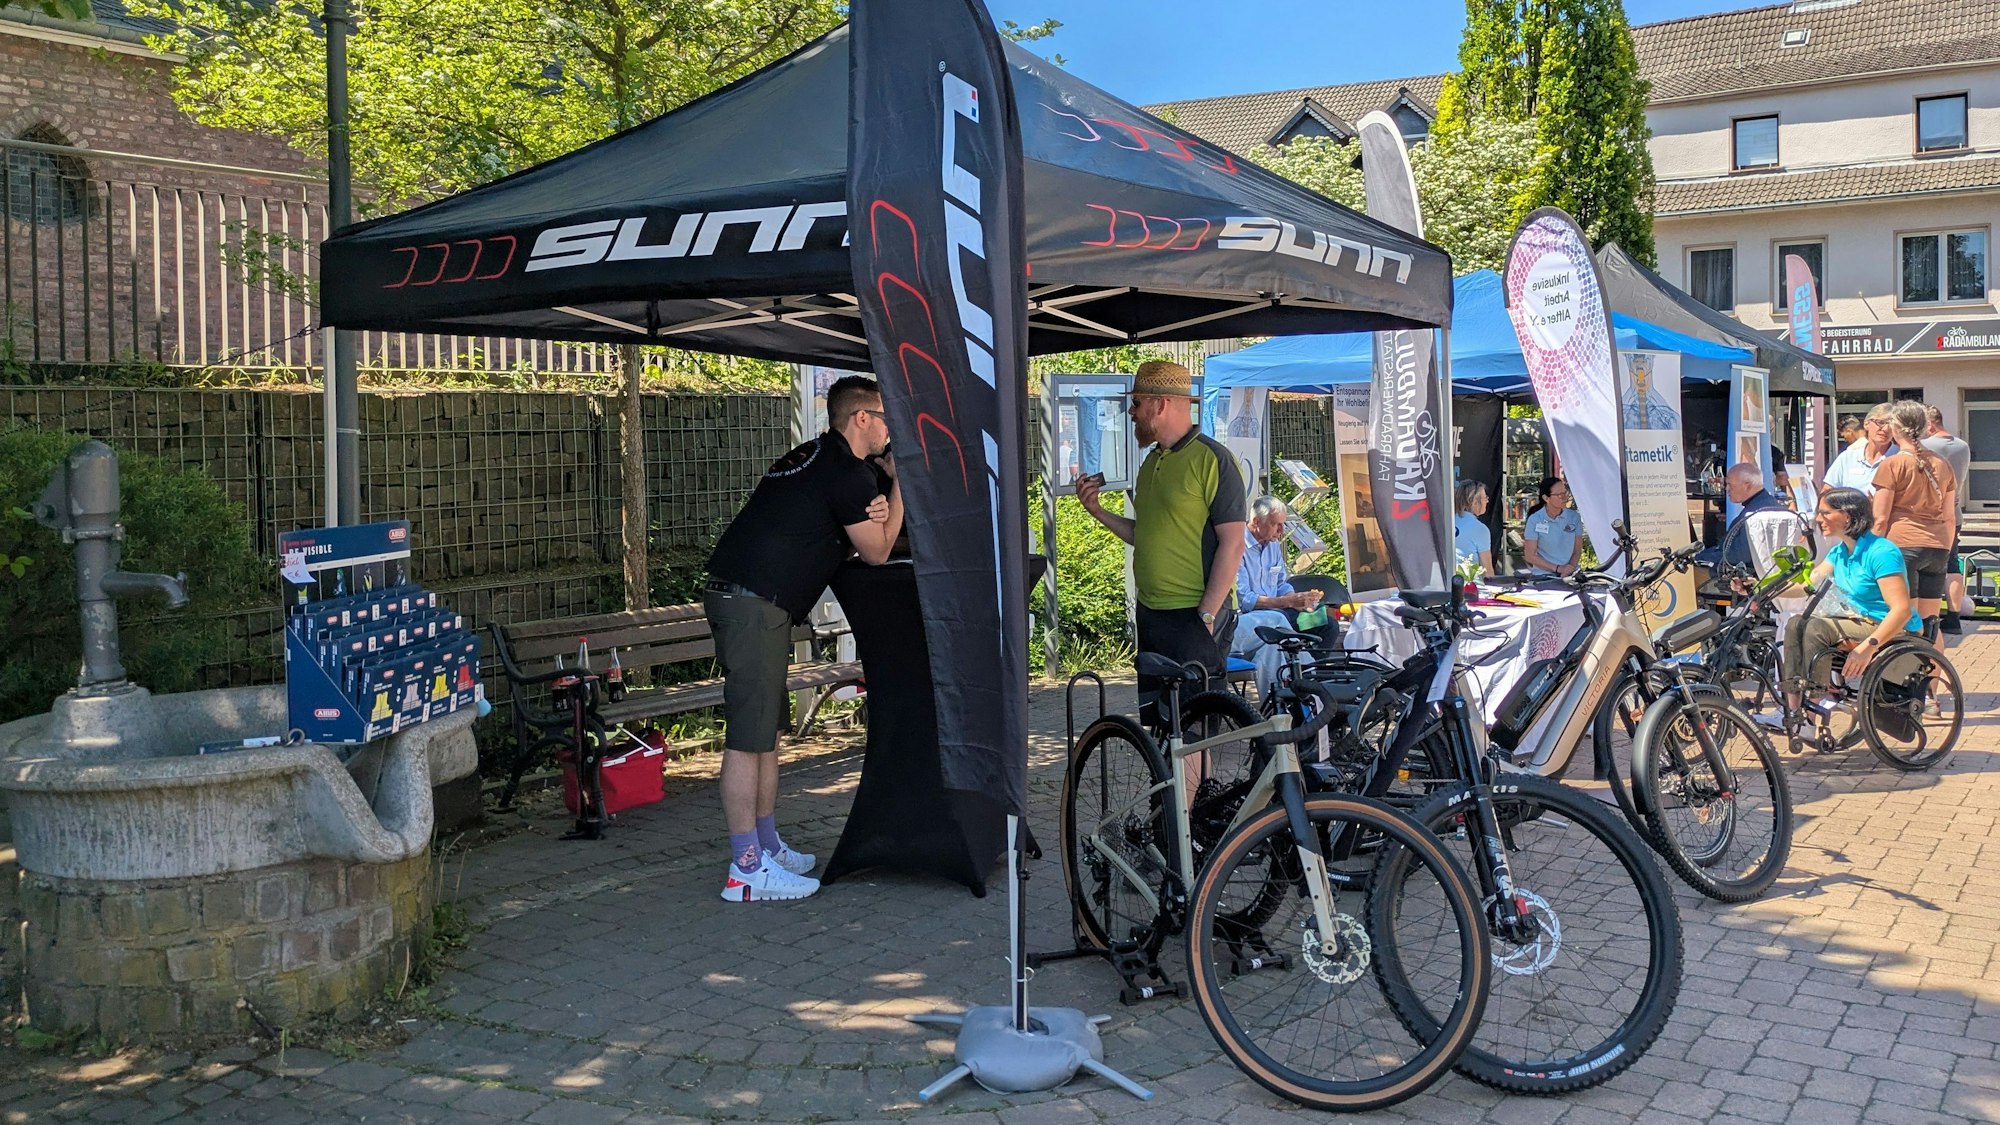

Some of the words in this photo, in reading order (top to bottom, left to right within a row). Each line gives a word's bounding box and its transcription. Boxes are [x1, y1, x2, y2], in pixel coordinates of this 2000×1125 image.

[1827, 327, 1872, 338] BEGEISTERUNG
[1822, 338, 1893, 354] FAHRRAD
[303, 543, 333, 557] VISIBLE
[1581, 665, 1610, 716] VICTORIA
